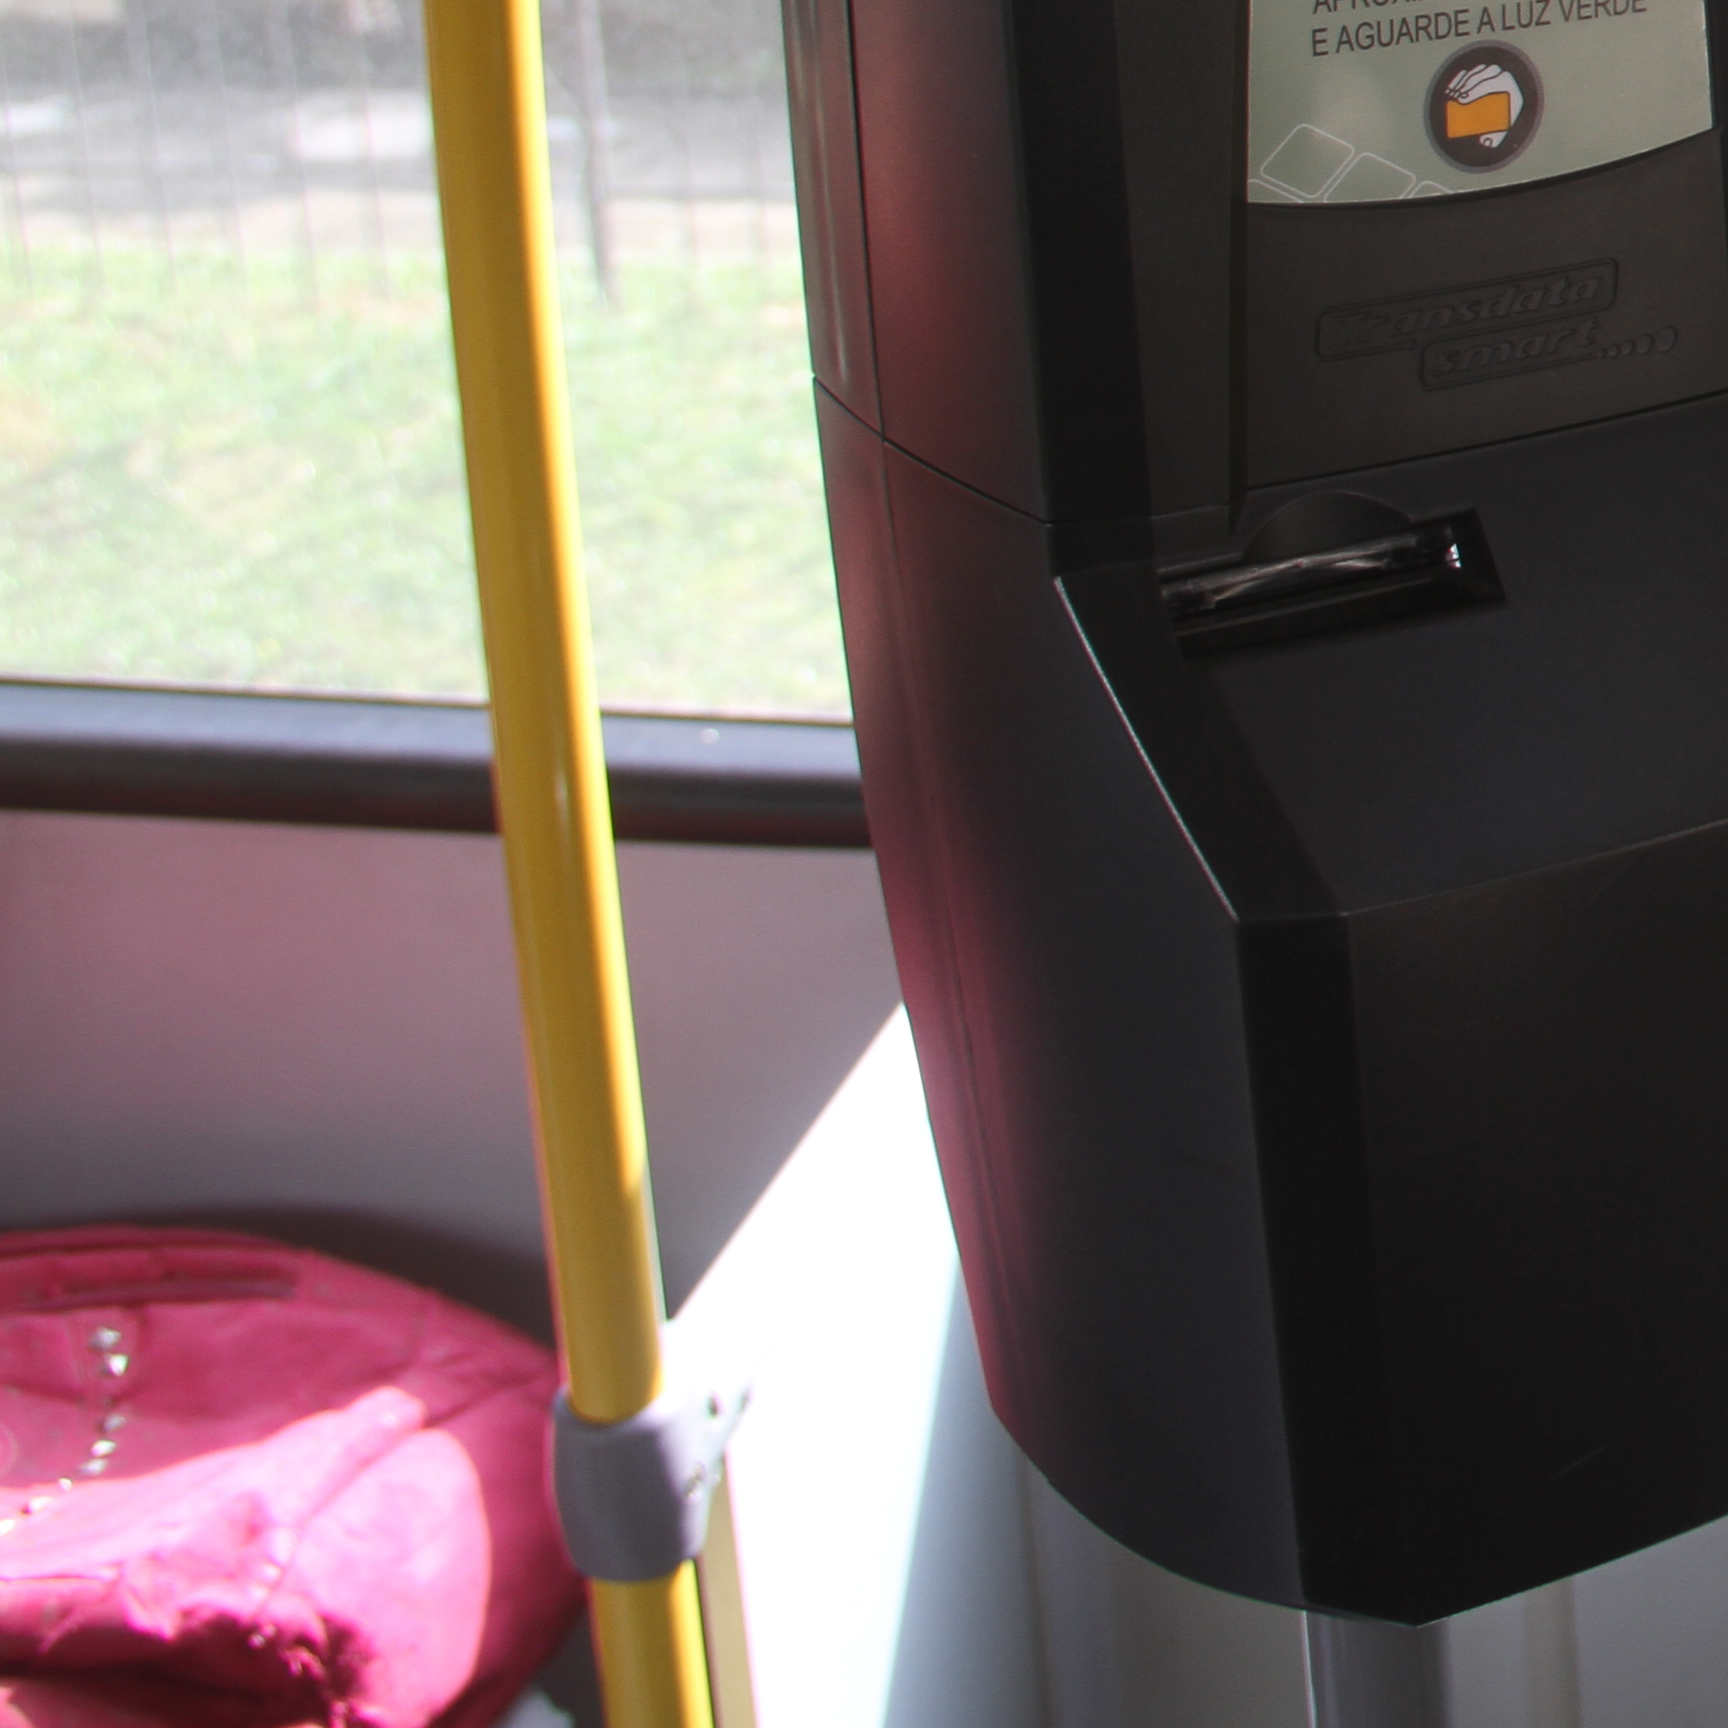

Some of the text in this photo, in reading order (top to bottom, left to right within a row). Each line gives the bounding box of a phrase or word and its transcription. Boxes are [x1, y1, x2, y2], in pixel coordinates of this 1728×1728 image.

[1311, 27, 1330, 57] E
[1335, 9, 1471, 55] AGUARDE
[1476, 5, 1496, 34] A
[1332, 275, 1604, 349] Transdata
[1430, 315, 1602, 377] smart
